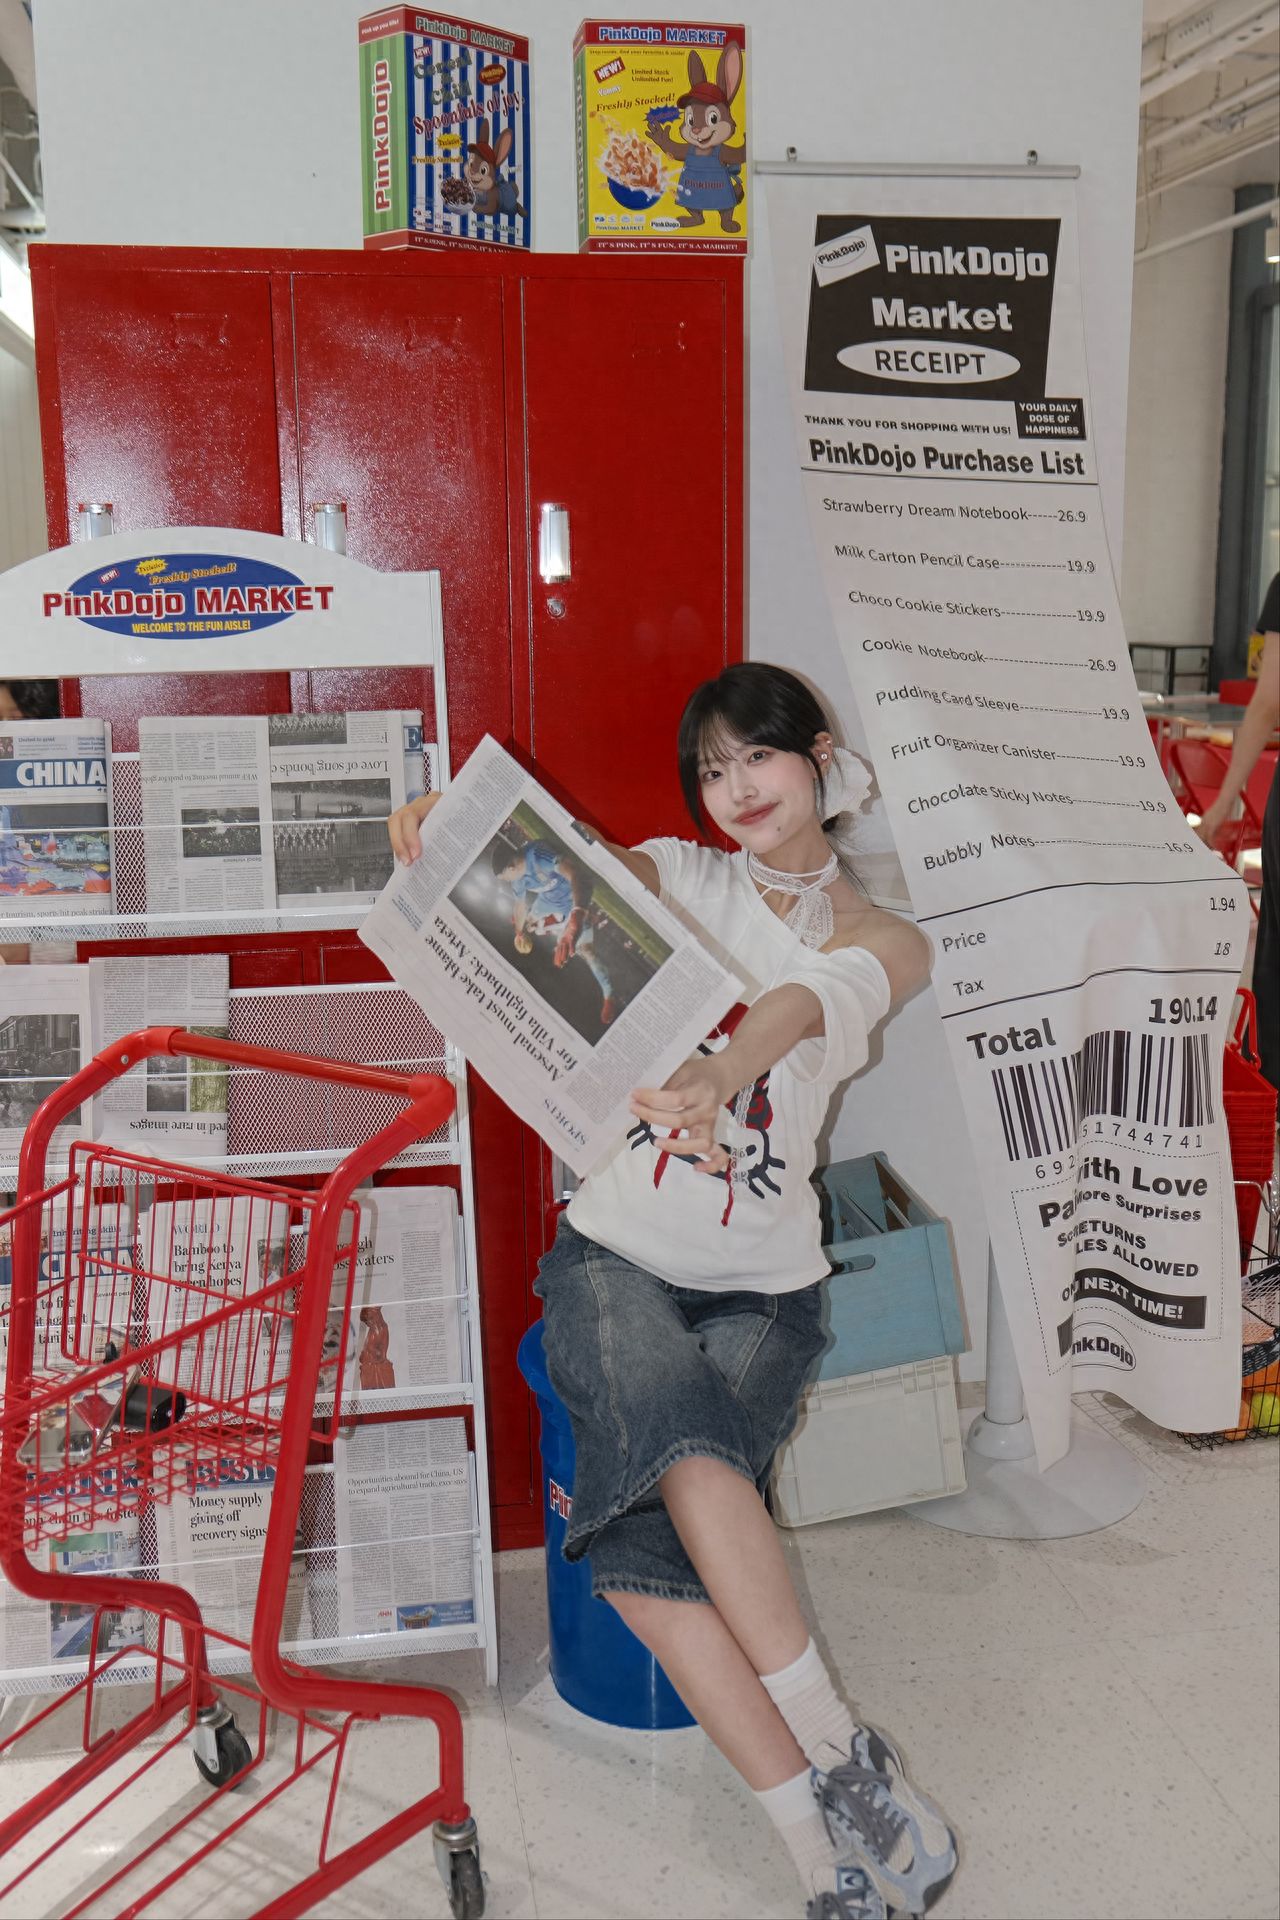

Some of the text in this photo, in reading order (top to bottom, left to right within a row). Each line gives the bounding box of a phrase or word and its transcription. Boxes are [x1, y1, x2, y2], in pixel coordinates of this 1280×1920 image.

[415, 16, 515, 55] PinkDojo MARKET
[599, 28, 726, 45] PinkDojo MARKET
[597, 60, 622, 80] NEW!
[596, 93, 676, 112] Freshly Stocked!
[374, 60, 392, 212] PinkDojo
[818, 239, 866, 265] PinkDojo
[885, 244, 1049, 281] PinkDojo
[871, 296, 1013, 332] Market
[874, 349, 986, 375] RECEIPT
[1019, 402, 1077, 413] YOUR DAILY
[1029, 414, 1070, 424] DOSE OF
[804, 415, 1011, 435] THANK YOU FOR SHOPPING WITH US!
[1025, 425, 1079, 435] HAPPINESS
[809, 438, 1085, 475] PinkDojo Purchase List
[823, 498, 1086, 523] Strawberry Dream Notebook 26.9
[835, 544, 1095, 573] Milk Carton Pencil Case 19.9
[100, 569, 118, 583] NEW!
[42, 585, 335, 619] PinkDojo MARKET
[848, 590, 1105, 622] Choco Cookie Stickers 19.9
[132, 620, 251, 633] WELCOME TO THE FUN AISLE!
[862, 638, 1117, 672] Cookie Notebook 26.9
[875, 685, 1130, 721] Pudding Card Sleeve 19.9
[891, 734, 1146, 769] Fruit Organizer Canister 19.9
[16, 760, 107, 787] CHINA
[280, 759, 388, 776] Love of song bonds
[907, 783, 1167, 815] Chocolate Sticky Notes 19.9
[923, 833, 1194, 871] Bubbly Notes 16.9
[1210, 897, 1236, 912] 1.94
[941, 929, 1231, 955] Price 18
[434, 915, 579, 1071] for Villa fightback: Arteta
[952, 979, 985, 997] Tax
[425, 935, 565, 1082] Arsenal must take blame
[1148, 996, 1218, 1025] 190.14
[966, 1017, 1057, 1060] Total
[129, 1118, 169, 1133] images
[171, 1120, 193, 1130] rare
[196, 1121, 206, 1135] in
[544, 1098, 587, 1146] SPORTS
[1132, 1165, 1208, 1197] Love
[1115, 1193, 1202, 1222] Surprises
[1113, 1244, 1199, 1278] ALLOWED
[1084, 1277, 1129, 1300] NEXT
[1131, 1293, 1184, 1320] TIME!
[453, 1467, 464, 1476] US
[188, 1492, 263, 1509] Money supply
[356, 1485, 380, 1496] expand
[380, 1481, 418, 1493] agricultural
[190, 1510, 242, 1528] giving off
[191, 1525, 268, 1542] recovery signs
